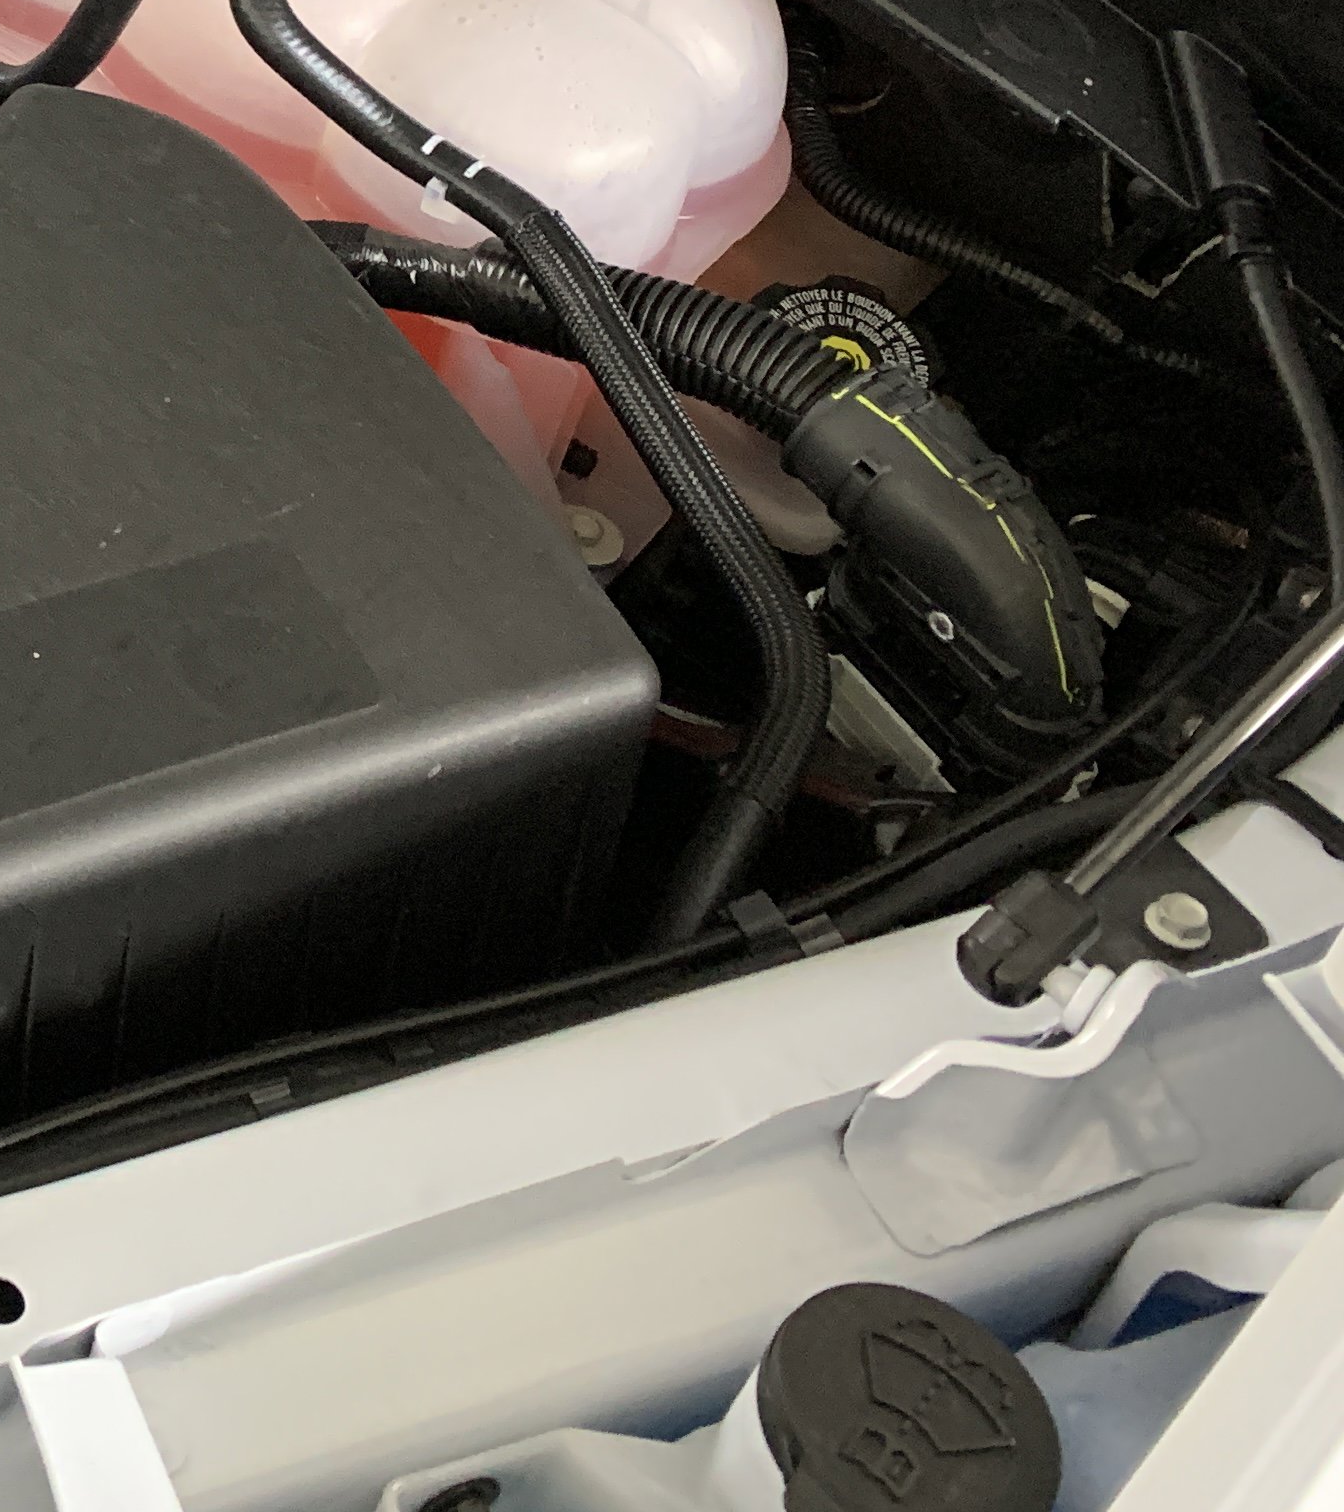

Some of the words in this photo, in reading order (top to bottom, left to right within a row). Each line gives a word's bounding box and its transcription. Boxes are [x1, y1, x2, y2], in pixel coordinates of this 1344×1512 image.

[780, 289, 829, 310] NETTOYER
[831, 289, 843, 302] LE
[847, 292, 896, 323] BOUCHON
[805, 301, 825, 315] QUE
[828, 301, 842, 314] DU
[846, 304, 885, 330] LIQUIDE
